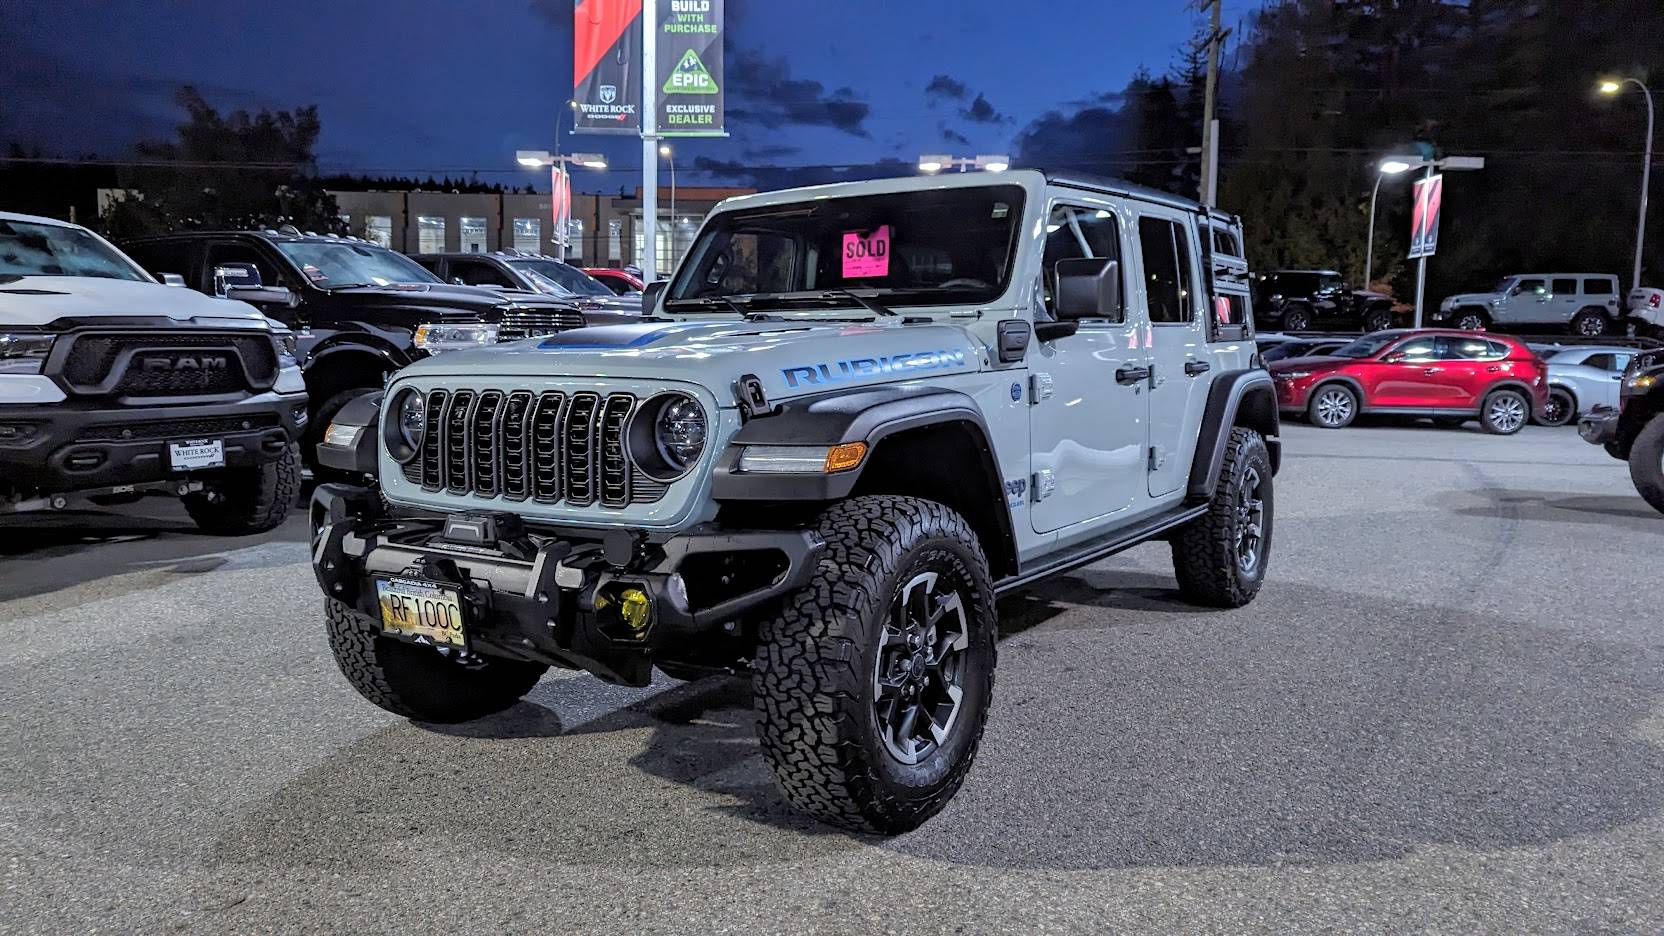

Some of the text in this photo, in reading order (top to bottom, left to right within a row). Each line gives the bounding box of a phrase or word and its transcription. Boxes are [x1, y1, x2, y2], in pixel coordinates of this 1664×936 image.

[672, 0, 709, 12] BUILD
[677, 14, 704, 22] WITH
[664, 24, 717, 33] PURCHASE
[673, 74, 709, 87] EPIC
[580, 104, 635, 113] WHITE ROCK
[666, 105, 715, 113] EXCLUSIVE
[669, 114, 712, 124] DEALER
[847, 240, 886, 258] SOLD
[143, 357, 226, 371] RAM
[782, 348, 965, 388] RUBICON
[174, 449, 199, 457] WHITE
[200, 446, 219, 454] ROCK
[390, 577, 422, 587] CASCADIA
[390, 593, 462, 632] RF100C
